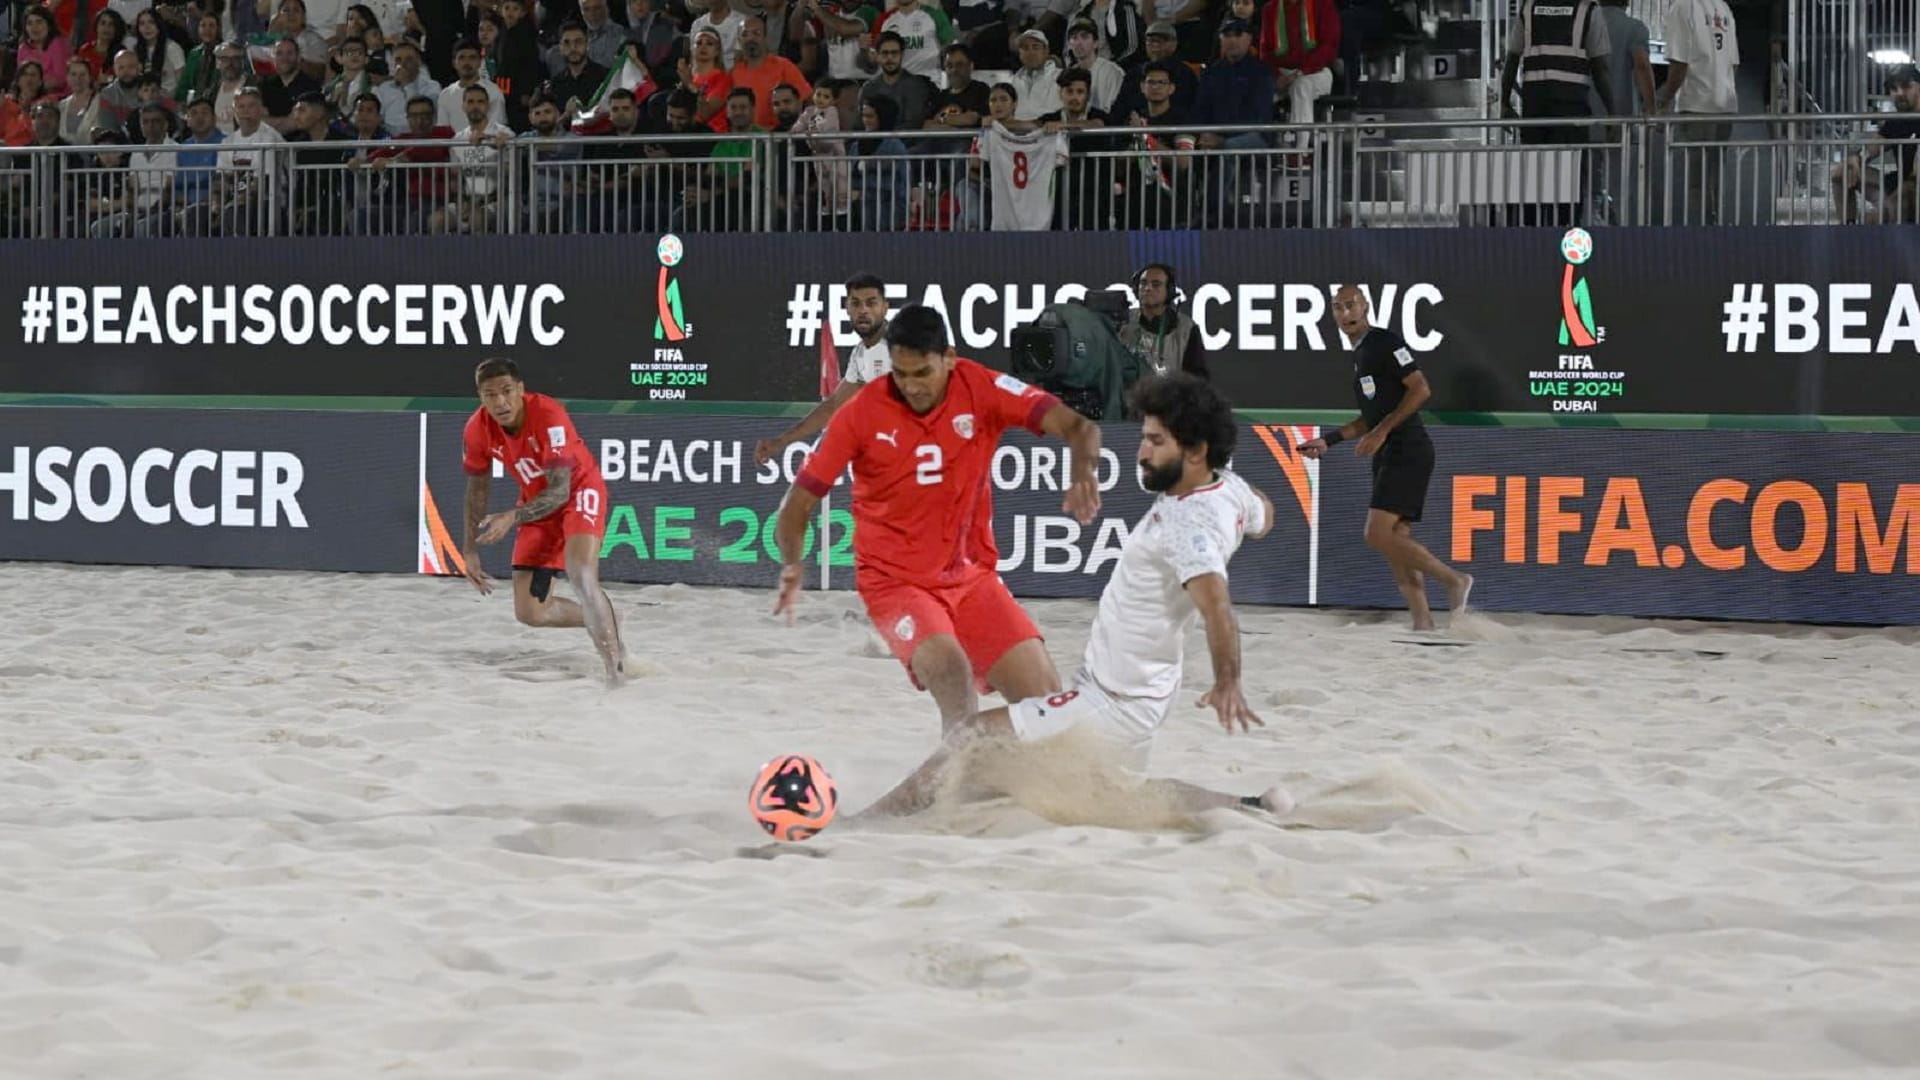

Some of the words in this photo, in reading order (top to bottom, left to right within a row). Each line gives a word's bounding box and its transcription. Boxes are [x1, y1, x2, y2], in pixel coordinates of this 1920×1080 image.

[904, 36, 924, 49] RAN
[1714, 33, 1724, 50] 3
[1435, 58, 1448, 75] D
[1013, 150, 1028, 189] 8
[22, 284, 565, 345] #BEACHSOCCERWC
[786, 283, 1444, 352] #BACHCERWC
[1721, 283, 1920, 353] #BEA
[1597, 326, 1606, 343] TM
[654, 348, 684, 362] FIFA
[1558, 355, 1594, 369] FIFA
[630, 363, 649, 371] BEACH
[650, 363, 672, 371] SOCCER
[672, 363, 694, 371] WORLD
[695, 363, 708, 371] CUP
[1529, 371, 1552, 379] BEACH
[1553, 371, 1580, 379] SOCCER
[1582, 371, 1608, 379] WORLD
[1609, 371, 1625, 379] CUP
[631, 372, 663, 385] UAE
[666, 372, 708, 385] 2024
[649, 389, 686, 399] DUBAI
[1530, 381, 1569, 395] UAE
[1573, 382, 1623, 396] 2024
[1553, 400, 1597, 411] DUBAI
[514, 457, 545, 486] 10
[601, 438, 742, 484] BEACH
[990, 445, 1120, 491] ORLD
[916, 444, 943, 485] 2
[576, 488, 599, 515] 10
[1451, 475, 1920, 574] FIFA.COM
[599, 505, 695, 561] AE
[719, 506, 855, 566] 202
[996, 515, 1132, 574] UBA
[1047, 690, 1079, 708] 8
